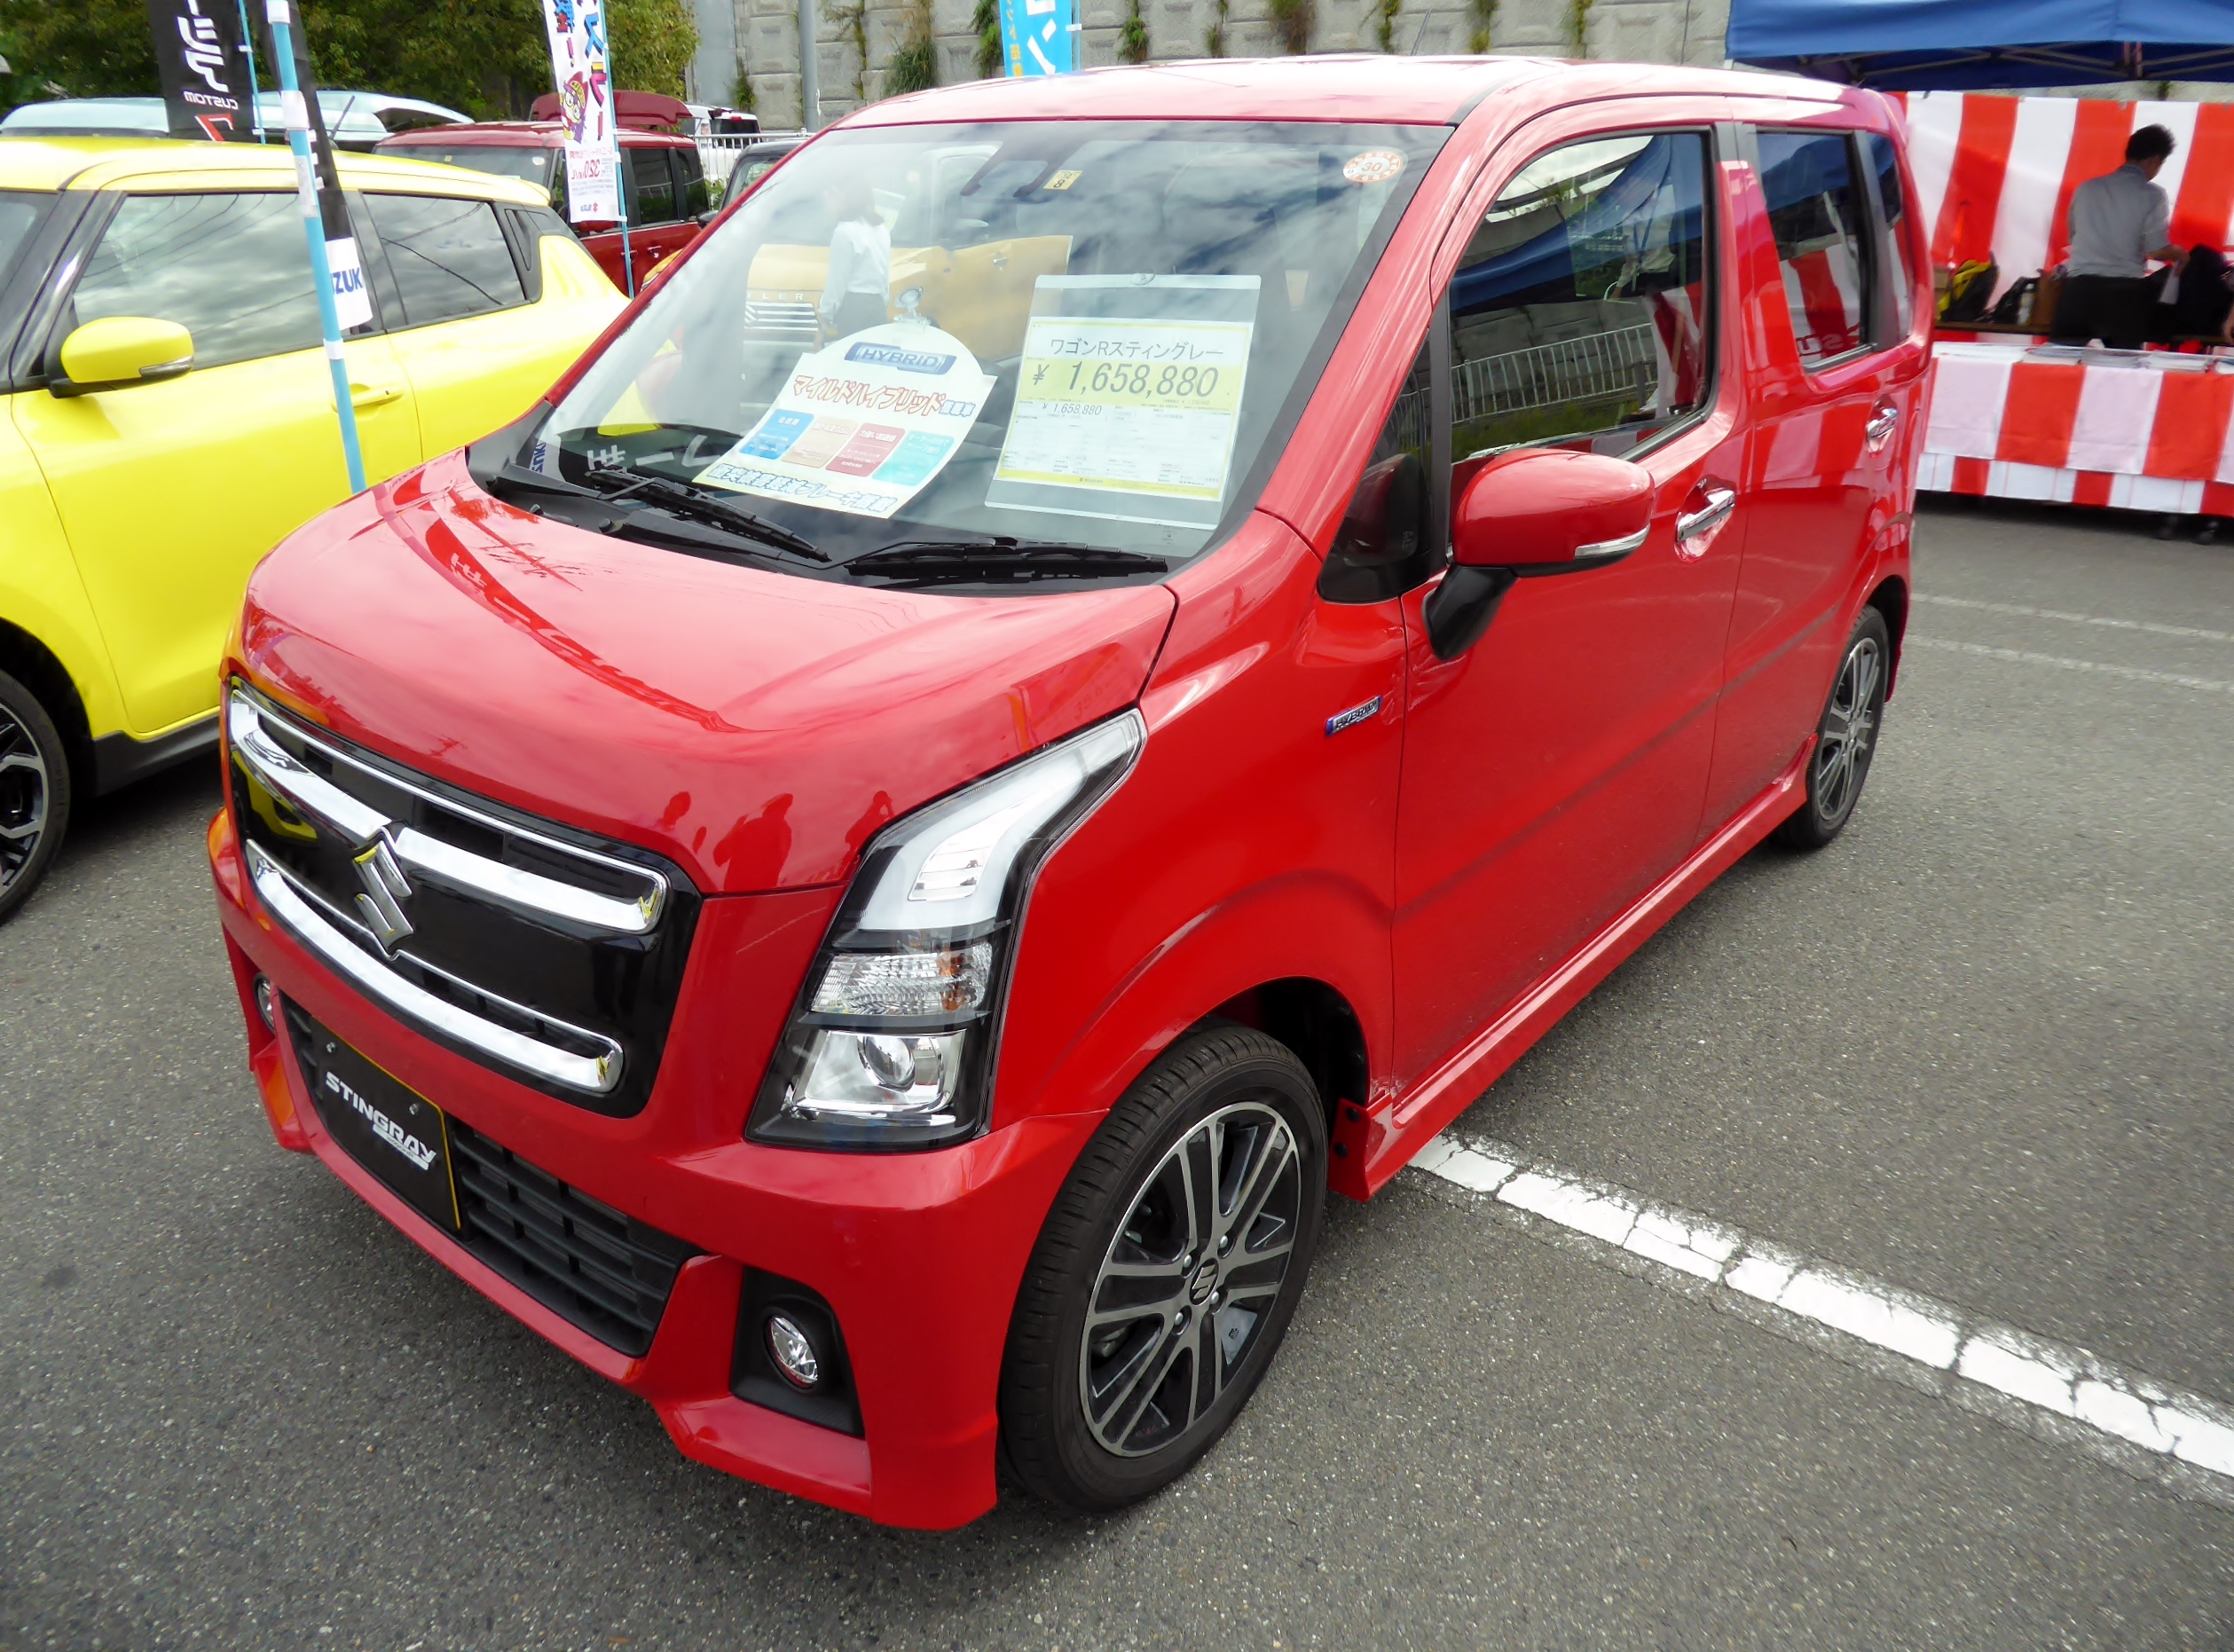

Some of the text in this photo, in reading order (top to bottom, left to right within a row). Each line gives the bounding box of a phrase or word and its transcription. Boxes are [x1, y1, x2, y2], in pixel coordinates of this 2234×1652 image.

[1361, 161, 1383, 172] 30
[1053, 179, 1066, 188] 8
[331, 266, 364, 295] ZUK
[861, 347, 940, 368] HYBRID
[1050, 337, 1224, 361] ワゴンRスティングレー
[1032, 360, 1220, 399] ¥ 1,658,880
[325, 1071, 437, 1164] STINGRAY
